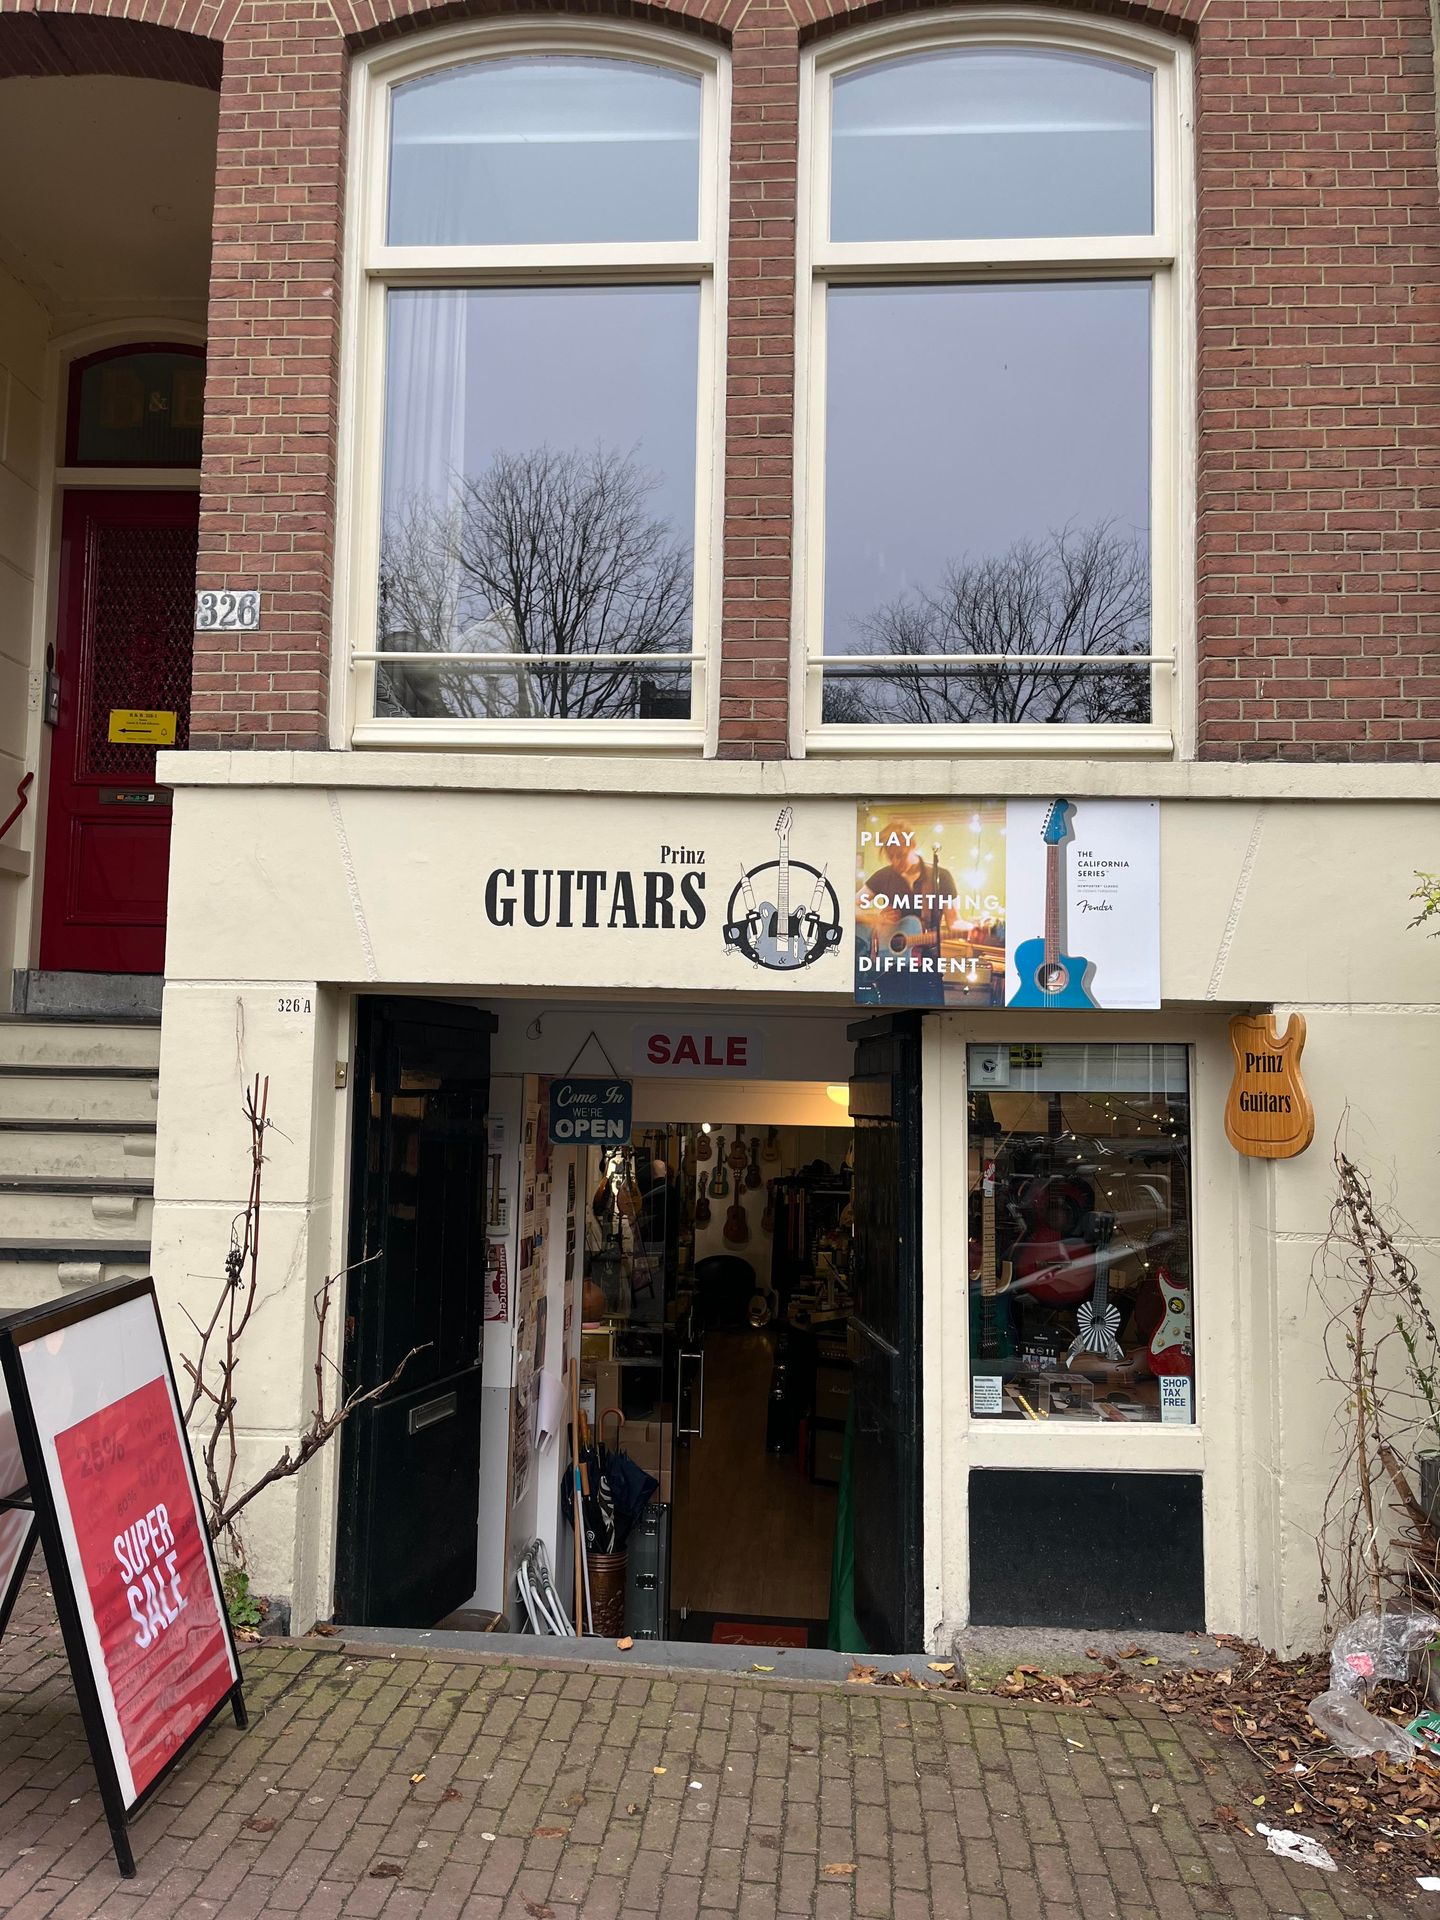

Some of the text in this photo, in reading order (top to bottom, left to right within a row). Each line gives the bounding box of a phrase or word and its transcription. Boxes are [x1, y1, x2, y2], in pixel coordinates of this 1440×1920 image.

[149, 390, 168, 412] &
[200, 593, 256, 627] 326
[860, 831, 916, 847] PLAY
[660, 845, 705, 864] Prinz
[1077, 860, 1130, 868] CALIFORNIA
[484, 868, 707, 930] GUITARS
[859, 893, 1000, 910] SOMETHING
[1076, 899, 1113, 914] Fender
[858, 957, 980, 974] DIFFERENT
[278, 998, 311, 1013] 326 A
[646, 1034, 748, 1066] SALE
[1245, 1052, 1284, 1073] Prinz
[557, 1085, 625, 1107] Come In
[1239, 1090, 1292, 1113] Guitars
[573, 1107, 603, 1118] WE'RE
[555, 1118, 624, 1138] OPEN
[1162, 1378, 1188, 1388] SHOP
[1162, 1388, 1181, 1397] TAX
[1163, 1397, 1186, 1406] FREE
[76, 1434, 125, 1479] 25%
[113, 1503, 175, 1585] SUPER
[126, 1549, 189, 1649] SALE
